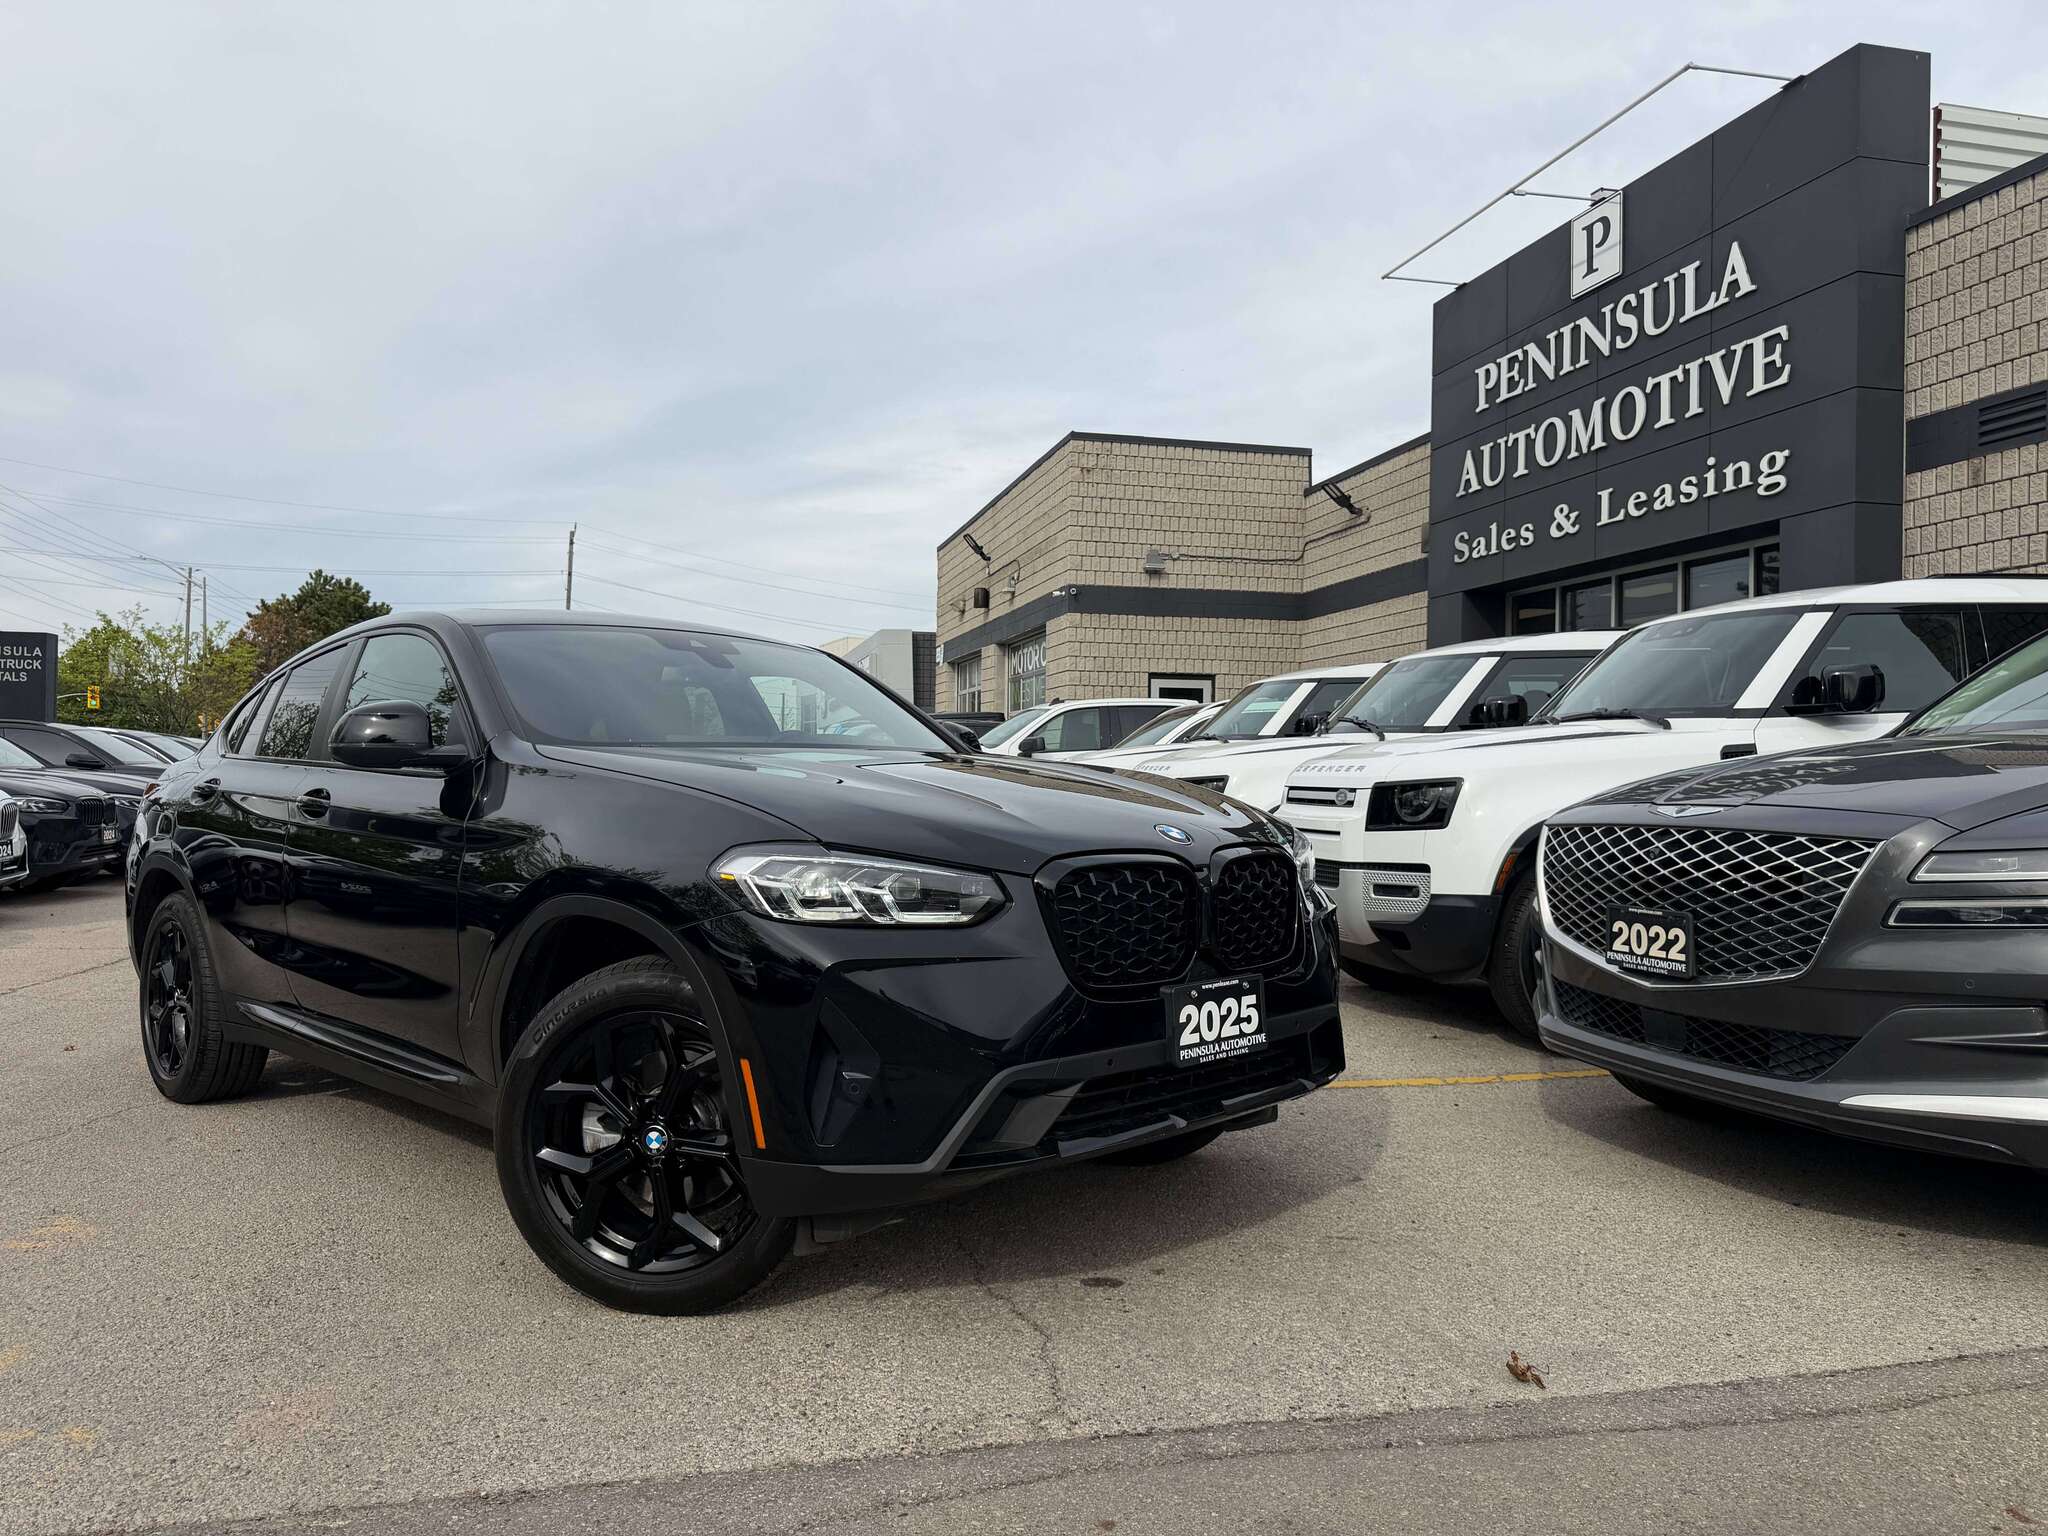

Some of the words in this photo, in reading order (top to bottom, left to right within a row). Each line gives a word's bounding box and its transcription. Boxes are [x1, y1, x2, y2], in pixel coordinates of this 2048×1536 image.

[1581, 214, 1612, 280] P
[1474, 240, 1758, 413] PENINSULA
[1455, 324, 1792, 498] AUTOMOTIVE
[1453, 521, 1535, 563] Sales
[1549, 503, 1580, 538] &
[1596, 449, 1791, 527] Leasing
[0, 645, 42, 657] SULA
[0, 659, 42, 670] TRUCK
[1612, 920, 1686, 961] 2022
[1606, 951, 1641, 964] PENINSULA
[1642, 957, 1687, 972] AUTOMOTIVE
[1648, 966, 1668, 975] LEASING
[1179, 994, 1259, 1046] 2025
[1180, 1043, 1220, 1060] PENINSULA
[1220, 1033, 1267, 1052] AUTOMOTIVE
[1200, 1053, 1215, 1063] SALES
[1216, 1051, 1227, 1060] AND
[1228, 1047, 1249, 1057] LEASING
